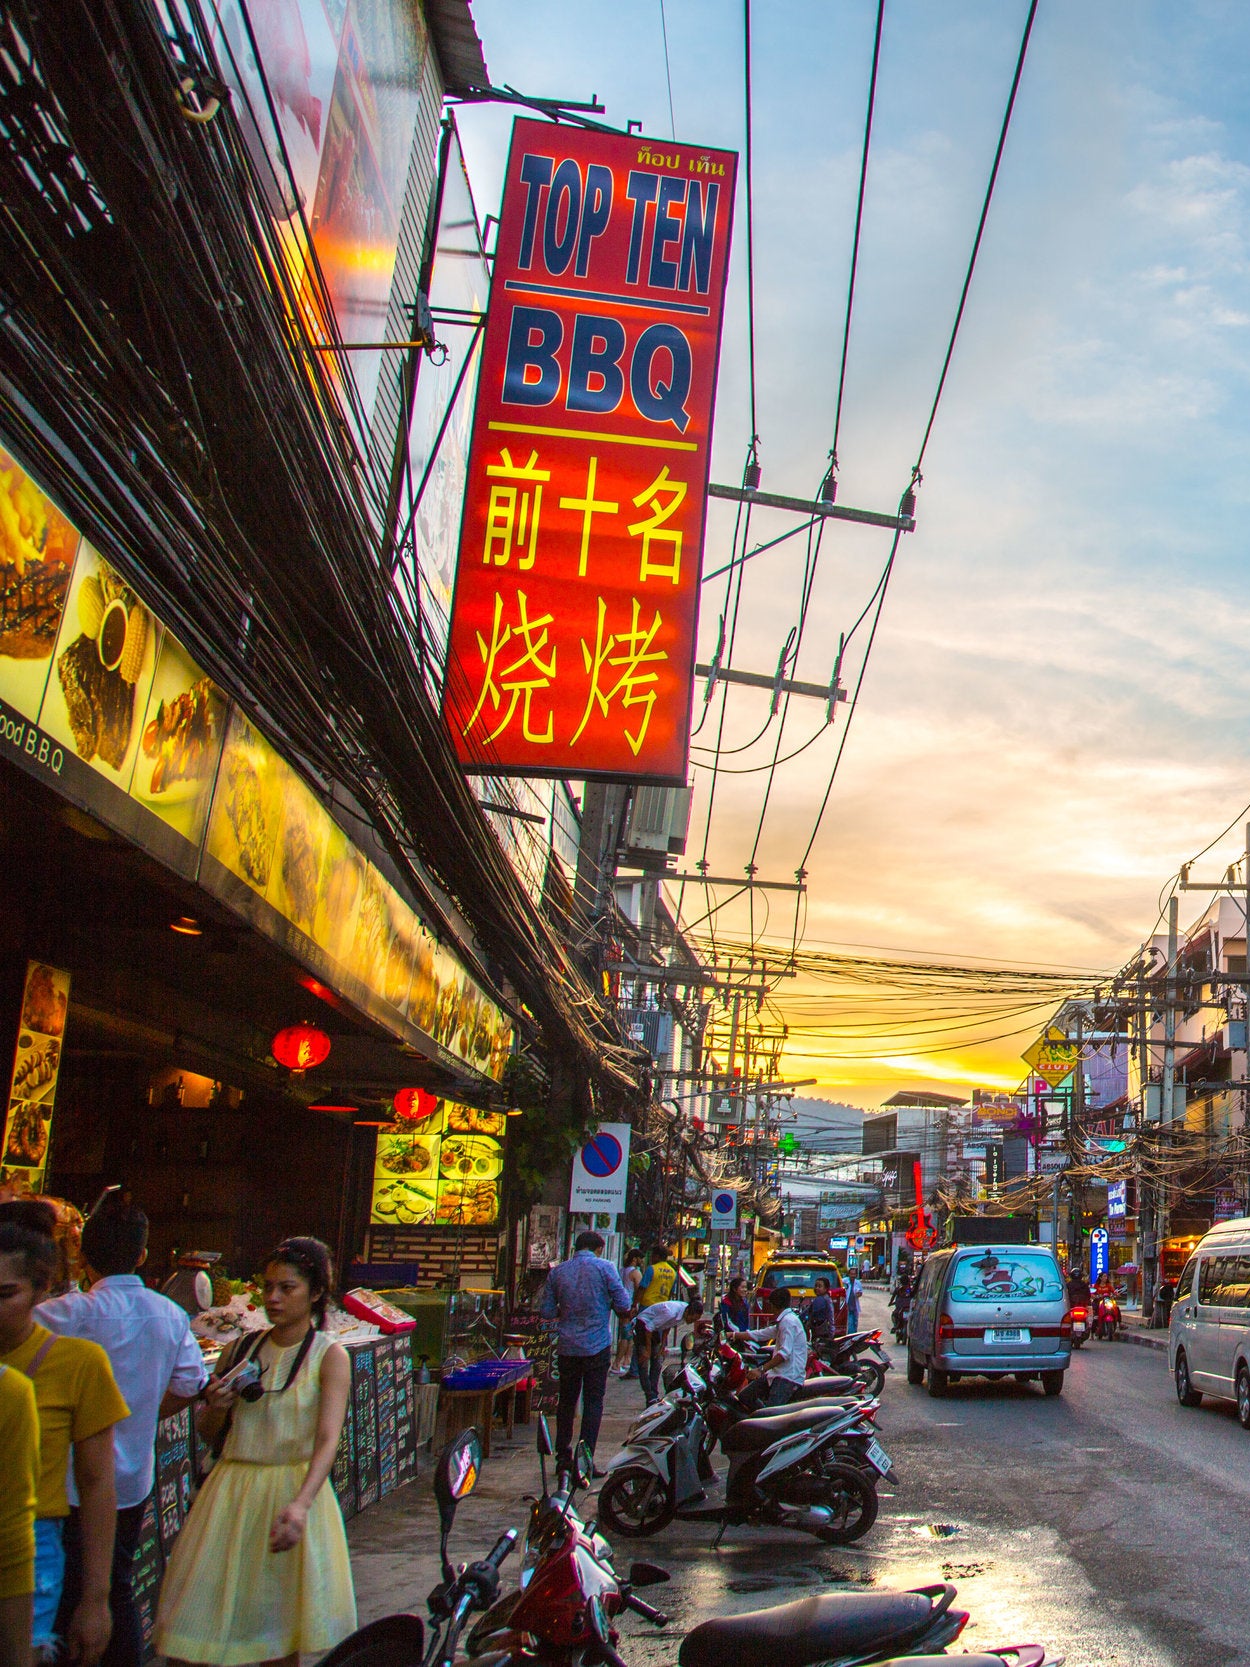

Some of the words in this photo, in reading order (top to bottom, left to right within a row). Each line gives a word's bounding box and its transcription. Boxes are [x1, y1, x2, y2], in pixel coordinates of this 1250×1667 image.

[517, 153, 614, 278] TOP
[625, 170, 720, 295] TEN
[501, 305, 693, 435] BBQ
[482, 447, 688, 586] 前十名
[462, 589, 669, 757] 烧烤
[25, 728, 64, 776] B.B.Q
